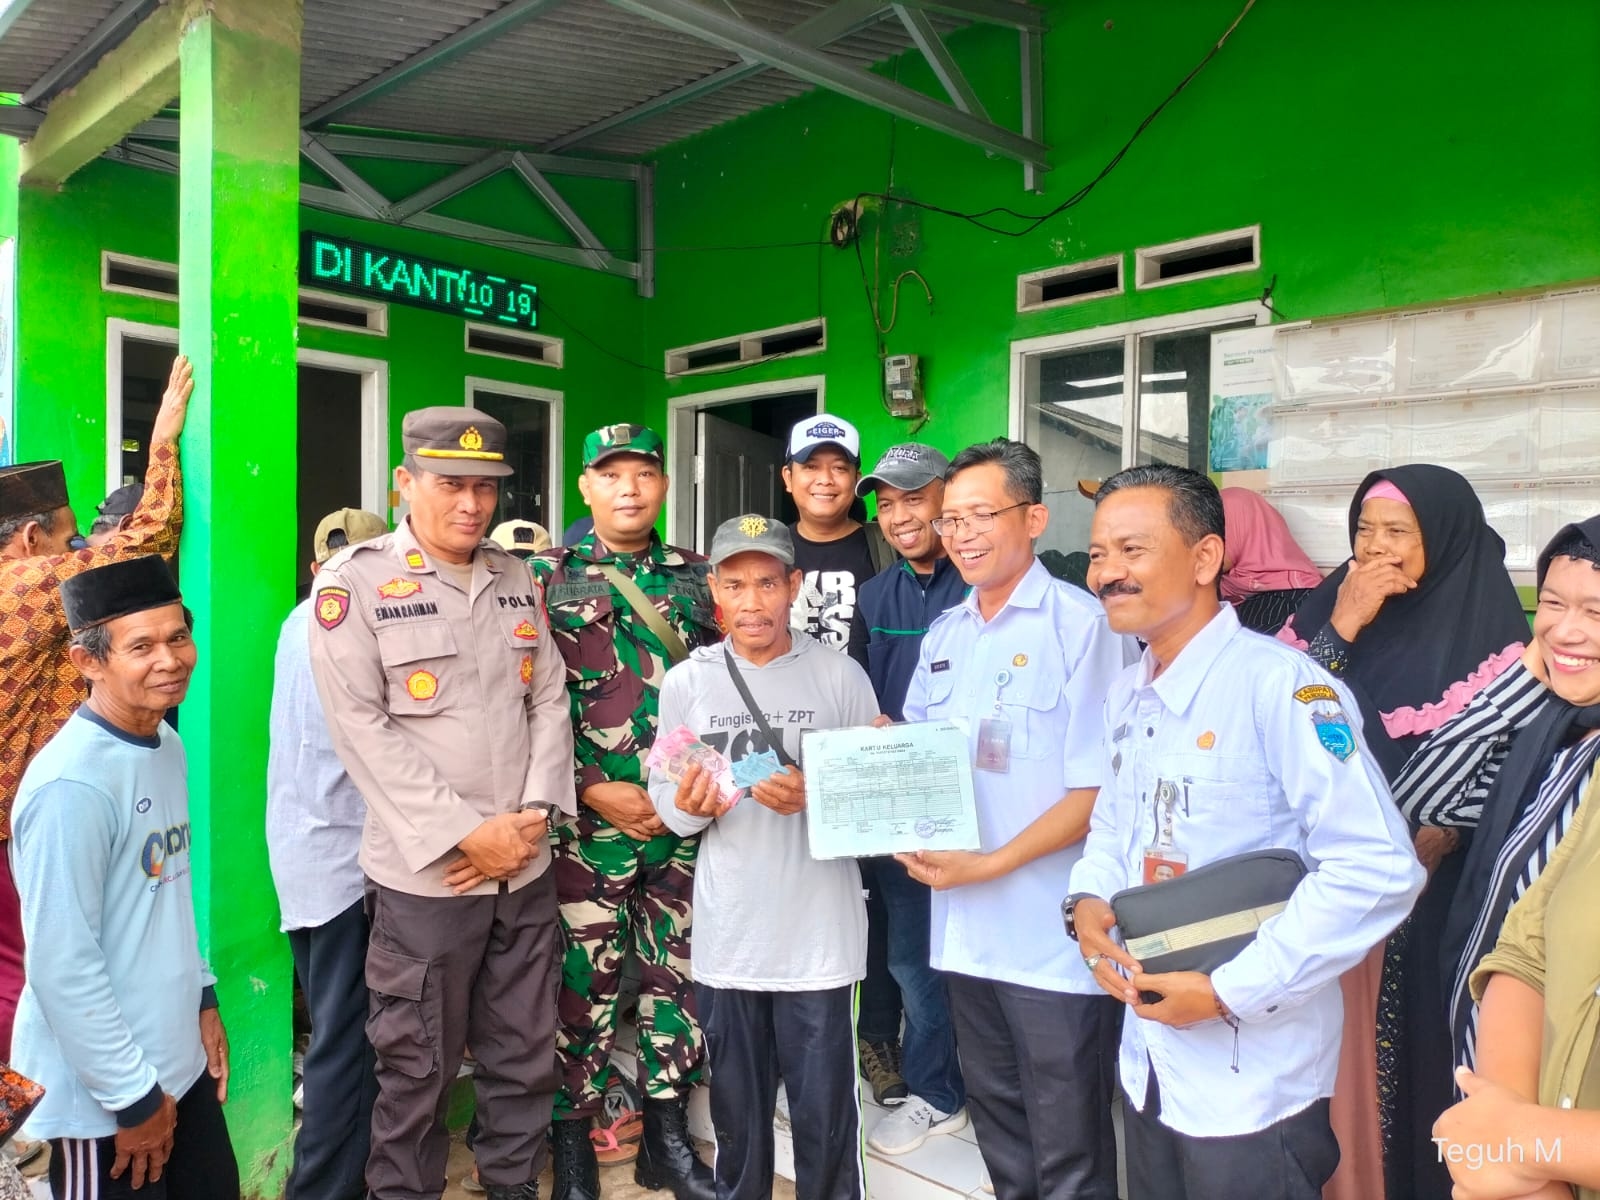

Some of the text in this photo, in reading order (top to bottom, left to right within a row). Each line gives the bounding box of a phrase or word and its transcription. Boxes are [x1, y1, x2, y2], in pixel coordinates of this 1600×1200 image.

[316, 240, 351, 282] DI
[468, 282, 531, 315] 10 19
[812, 427, 840, 435] EIGER
[710, 710, 771, 728] Fungisa
[788, 710, 815, 724] ZPT
[883, 742, 914, 751] KELUARGA
